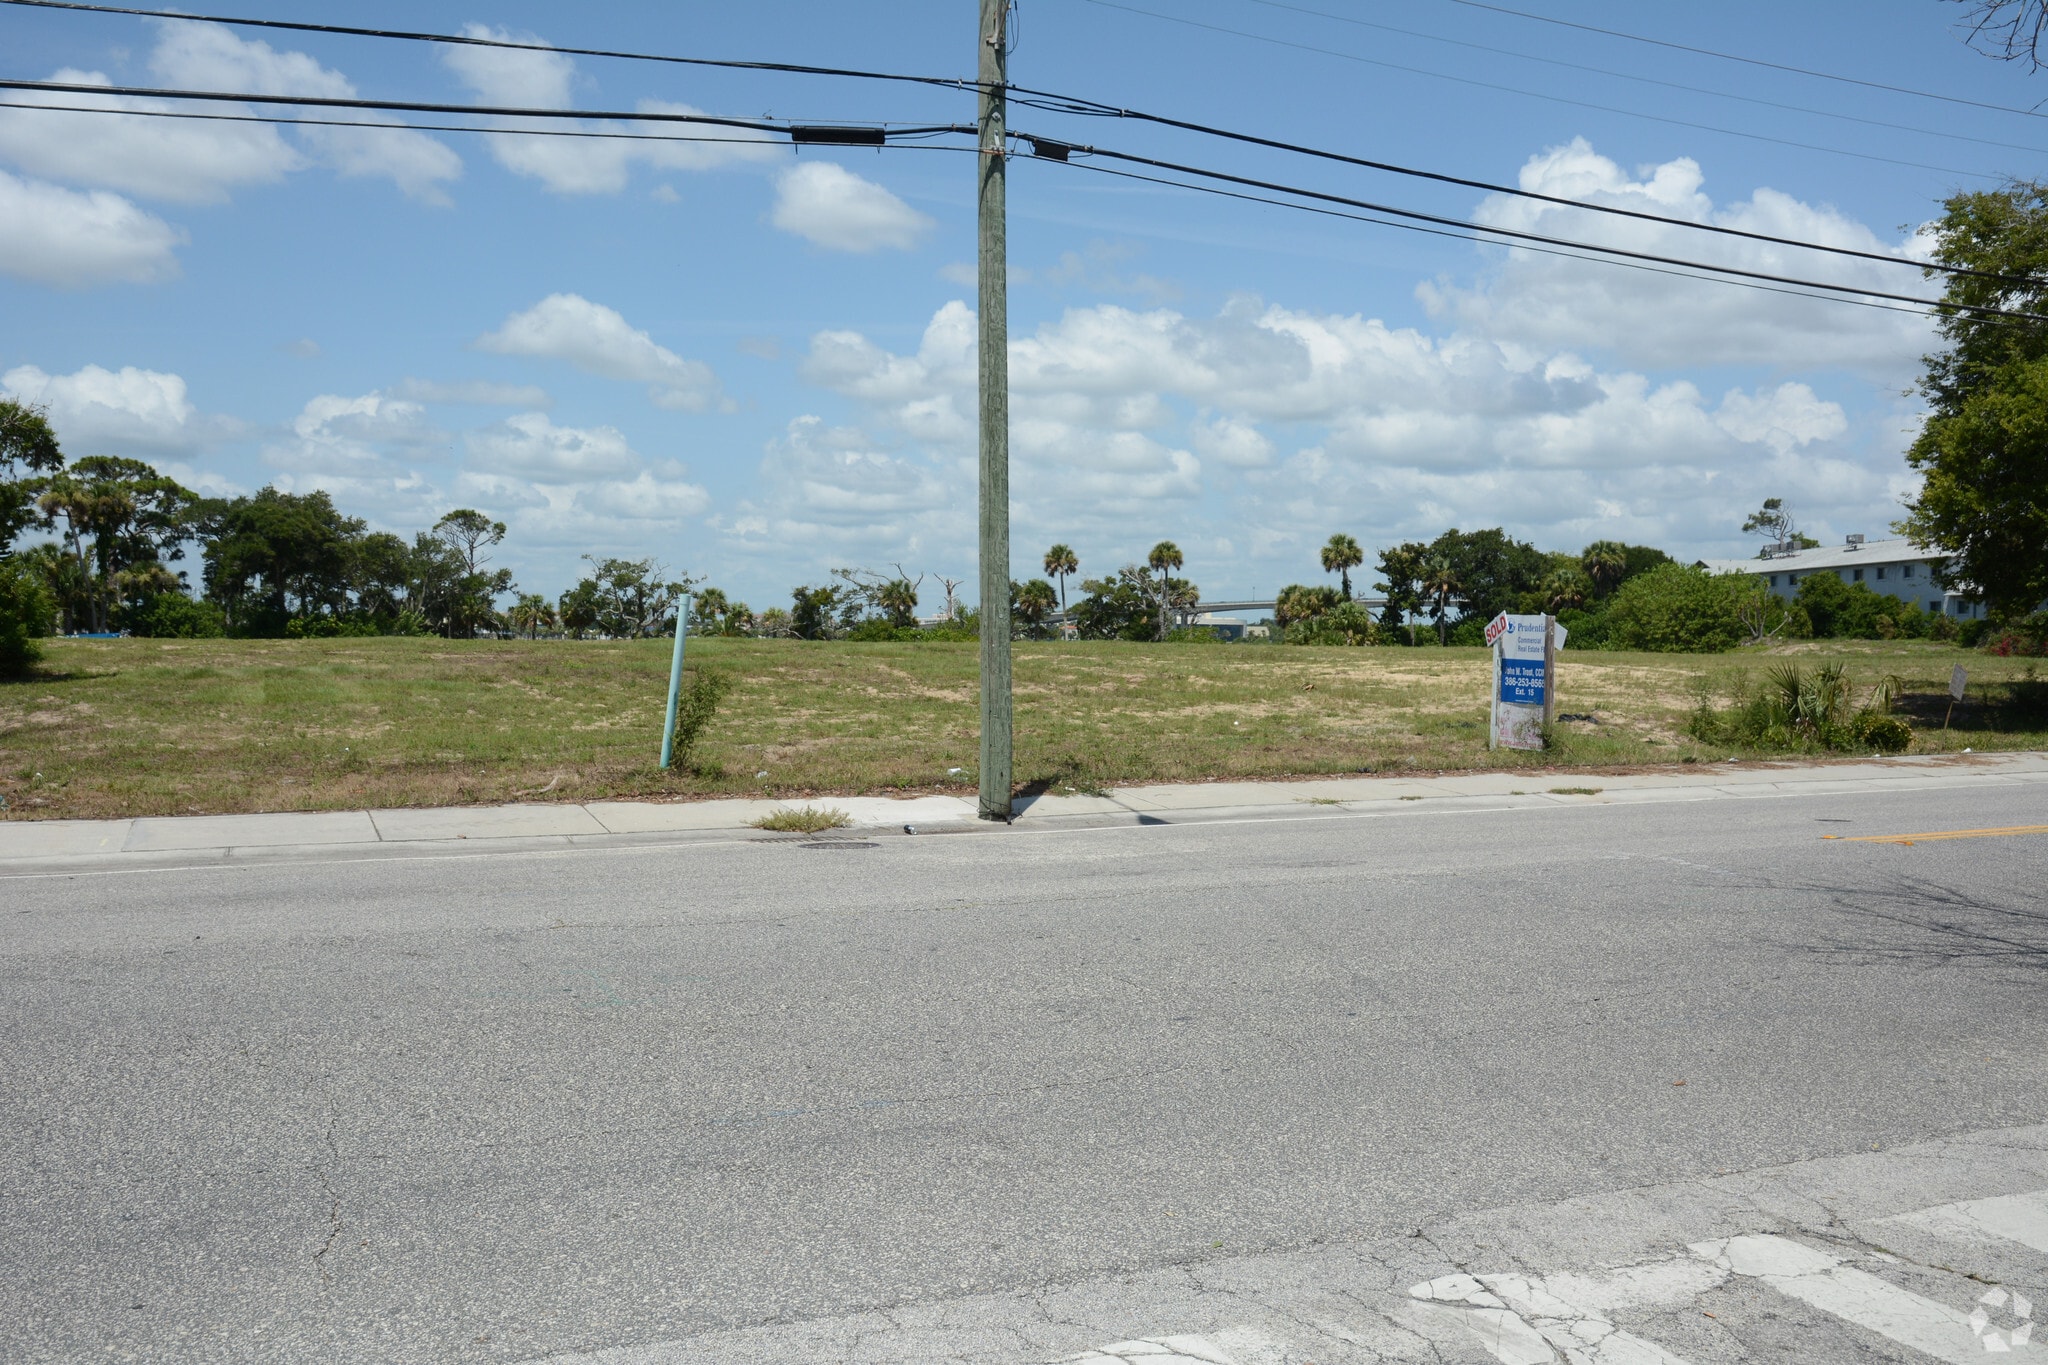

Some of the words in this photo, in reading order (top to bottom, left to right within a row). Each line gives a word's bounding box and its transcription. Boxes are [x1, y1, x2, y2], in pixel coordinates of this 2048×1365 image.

[1486, 616, 1506, 643] SOLD
[1518, 623, 1545, 632] Prudentia
[1518, 636, 1542, 644] Commercial
[1528, 645, 1540, 653] Estate
